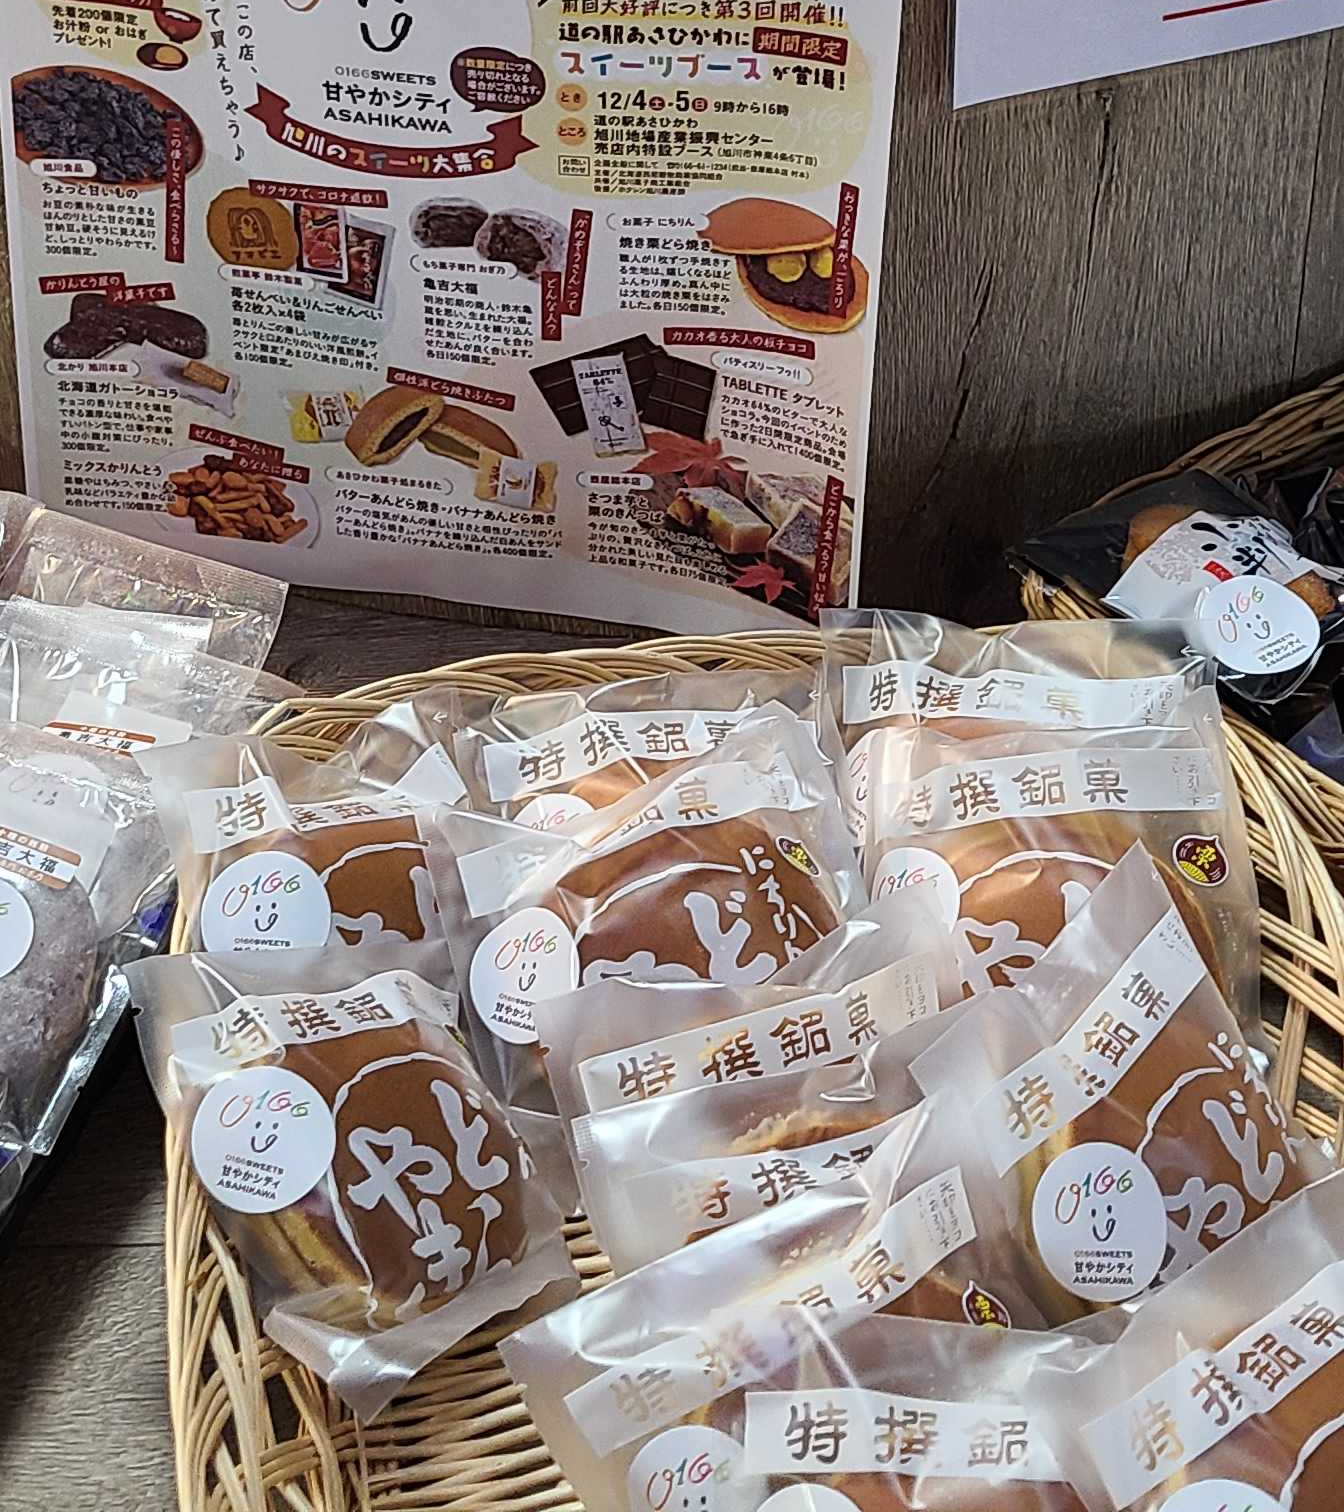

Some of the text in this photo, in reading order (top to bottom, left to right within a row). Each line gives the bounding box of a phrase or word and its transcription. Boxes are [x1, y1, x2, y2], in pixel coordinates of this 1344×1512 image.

[95, 25, 109, 35] or
[757, 30, 844, 61] 期間限定
[335, 66, 437, 86] 0166SWEETS
[560, 53, 761, 80] スイーツブース
[322, 81, 452, 114] 甘やかシティ
[560, 93, 581, 102] とき
[324, 107, 452, 134] ASAHIKAWA
[558, 126, 586, 137] ところ
[42, 182, 138, 199] ちょっと甘いもの
[619, 237, 712, 251] 焼き栗どら焼き
[58, 381, 179, 399] 北海道ガトーショコラ
[721, 376, 844, 417] TABLETTE タブレット
[63, 461, 162, 477] ミックスかりんとう
[222, 870, 300, 917] 0166
[219, 1093, 310, 1128] 0166
[1056, 1166, 1133, 1224] 0166
[1075, 1262, 1134, 1275] 甘やかシティ
